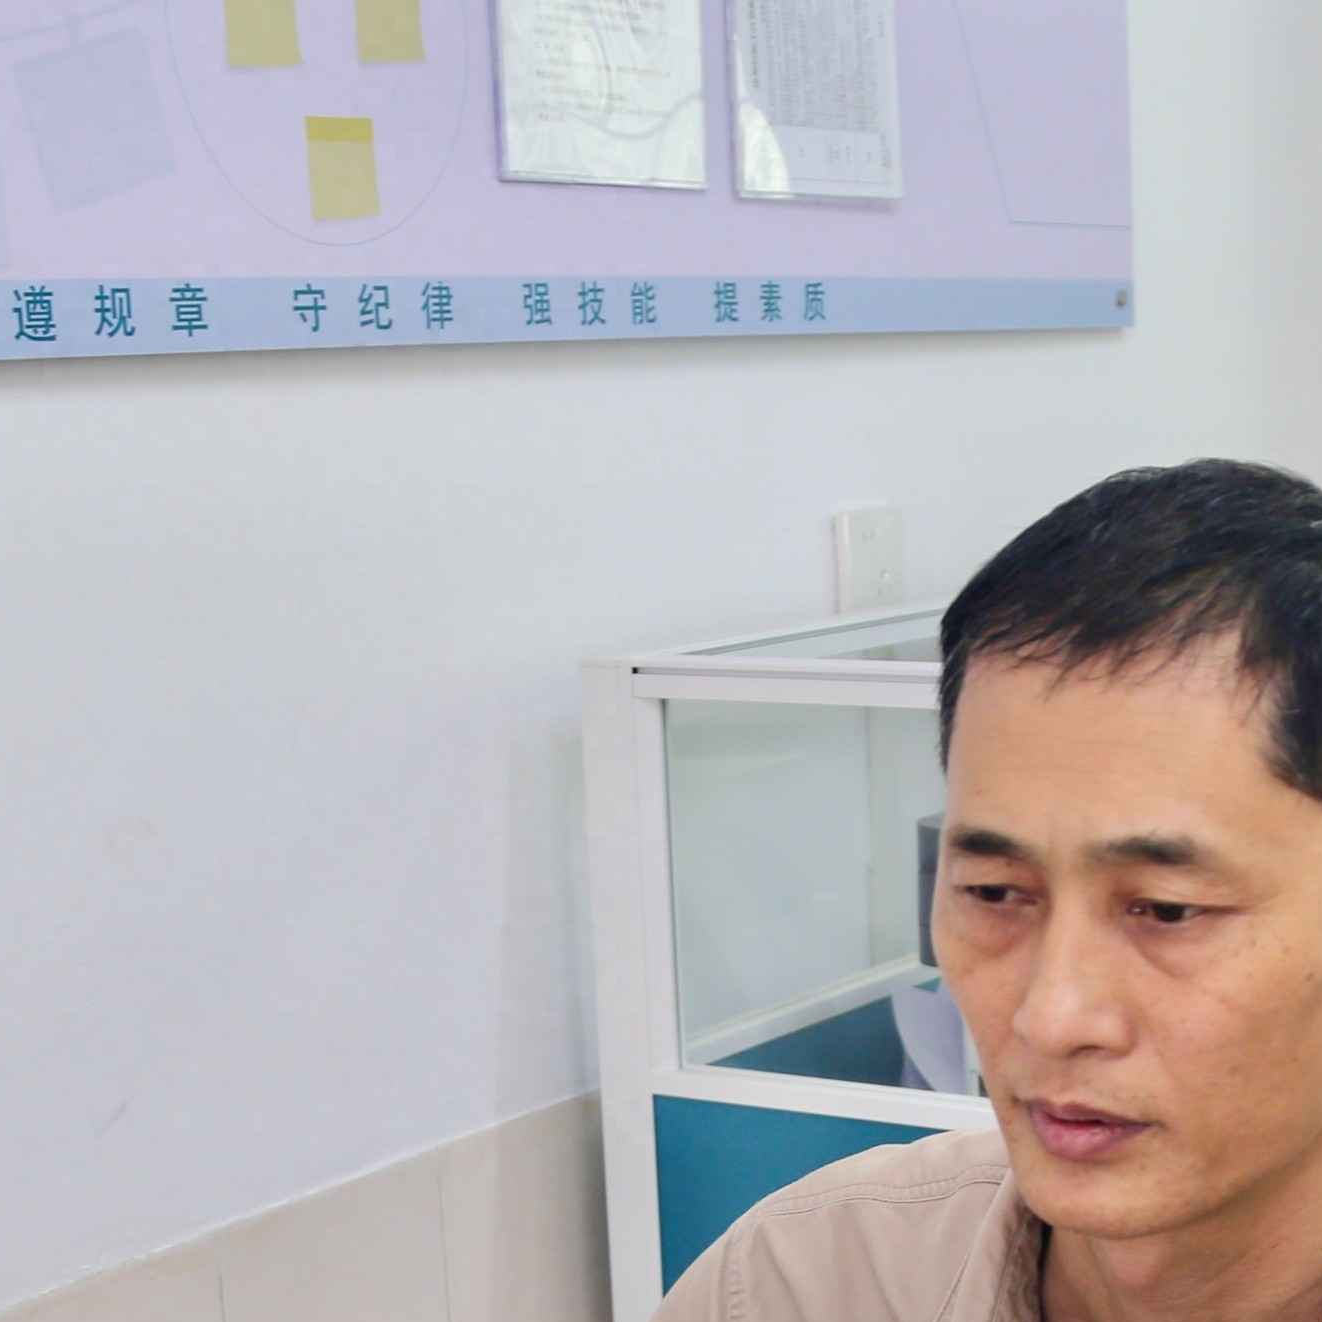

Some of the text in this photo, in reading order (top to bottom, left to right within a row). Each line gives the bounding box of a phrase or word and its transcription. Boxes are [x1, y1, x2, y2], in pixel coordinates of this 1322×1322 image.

[13, 280, 827, 341] 遵规章 守纪律 强技能 提素质
